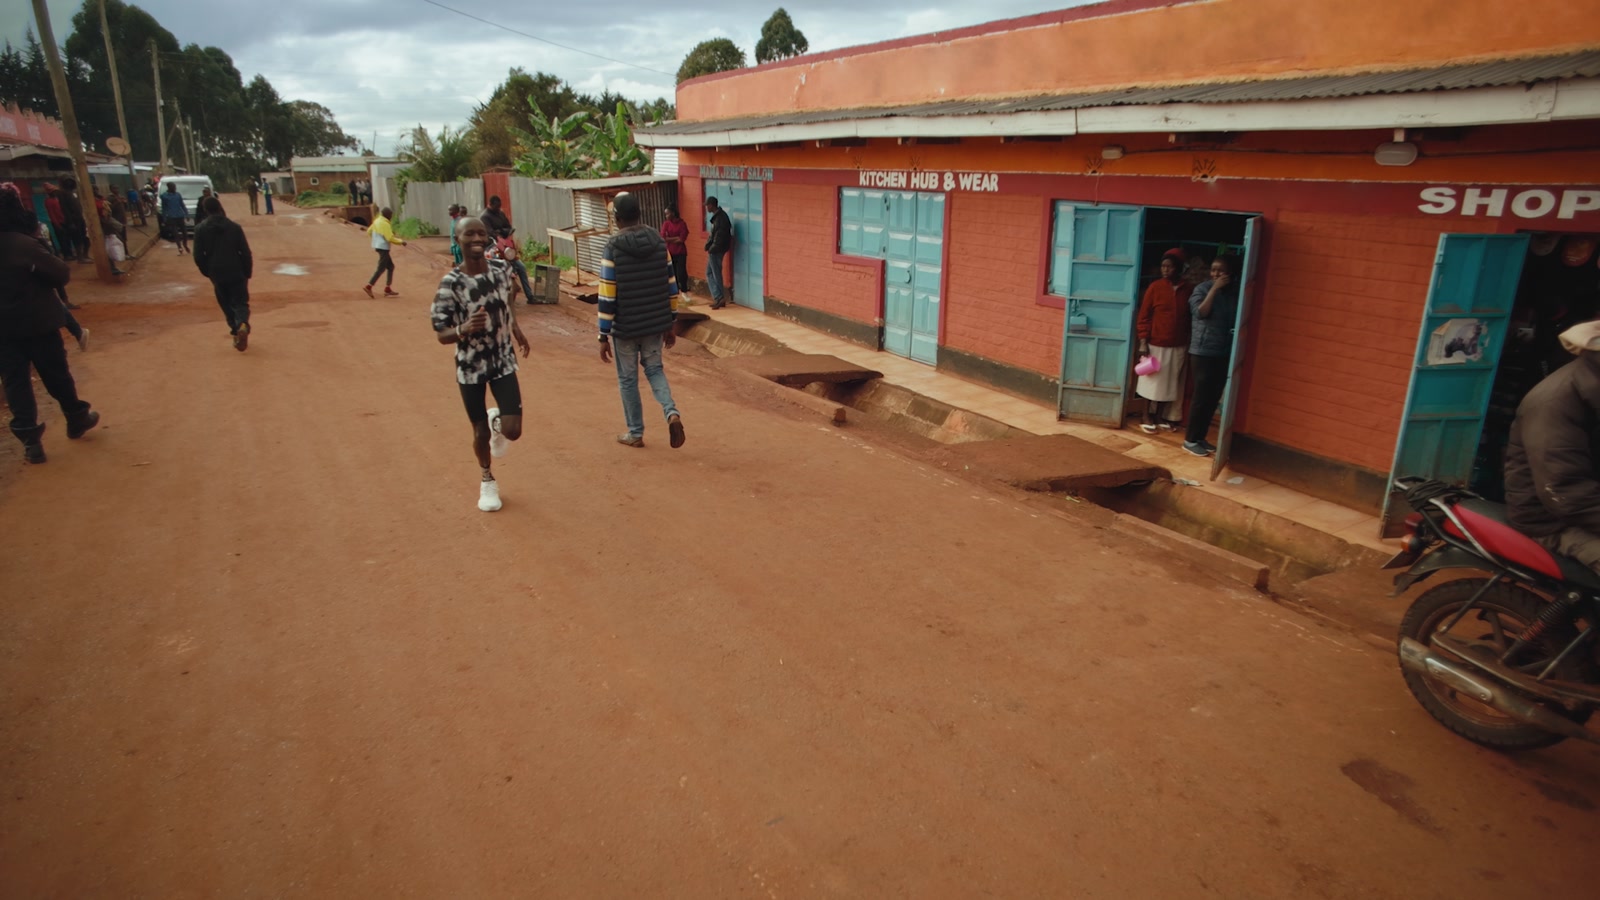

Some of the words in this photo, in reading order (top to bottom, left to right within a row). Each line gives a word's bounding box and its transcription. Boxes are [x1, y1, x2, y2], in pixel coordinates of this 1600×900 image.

[748, 167, 773, 181] SALON
[859, 171, 907, 188] KITCHEN
[911, 172, 939, 190] HUB
[943, 172, 956, 192] &
[959, 173, 999, 192] WEAR
[1417, 187, 1600, 219] SHOP
